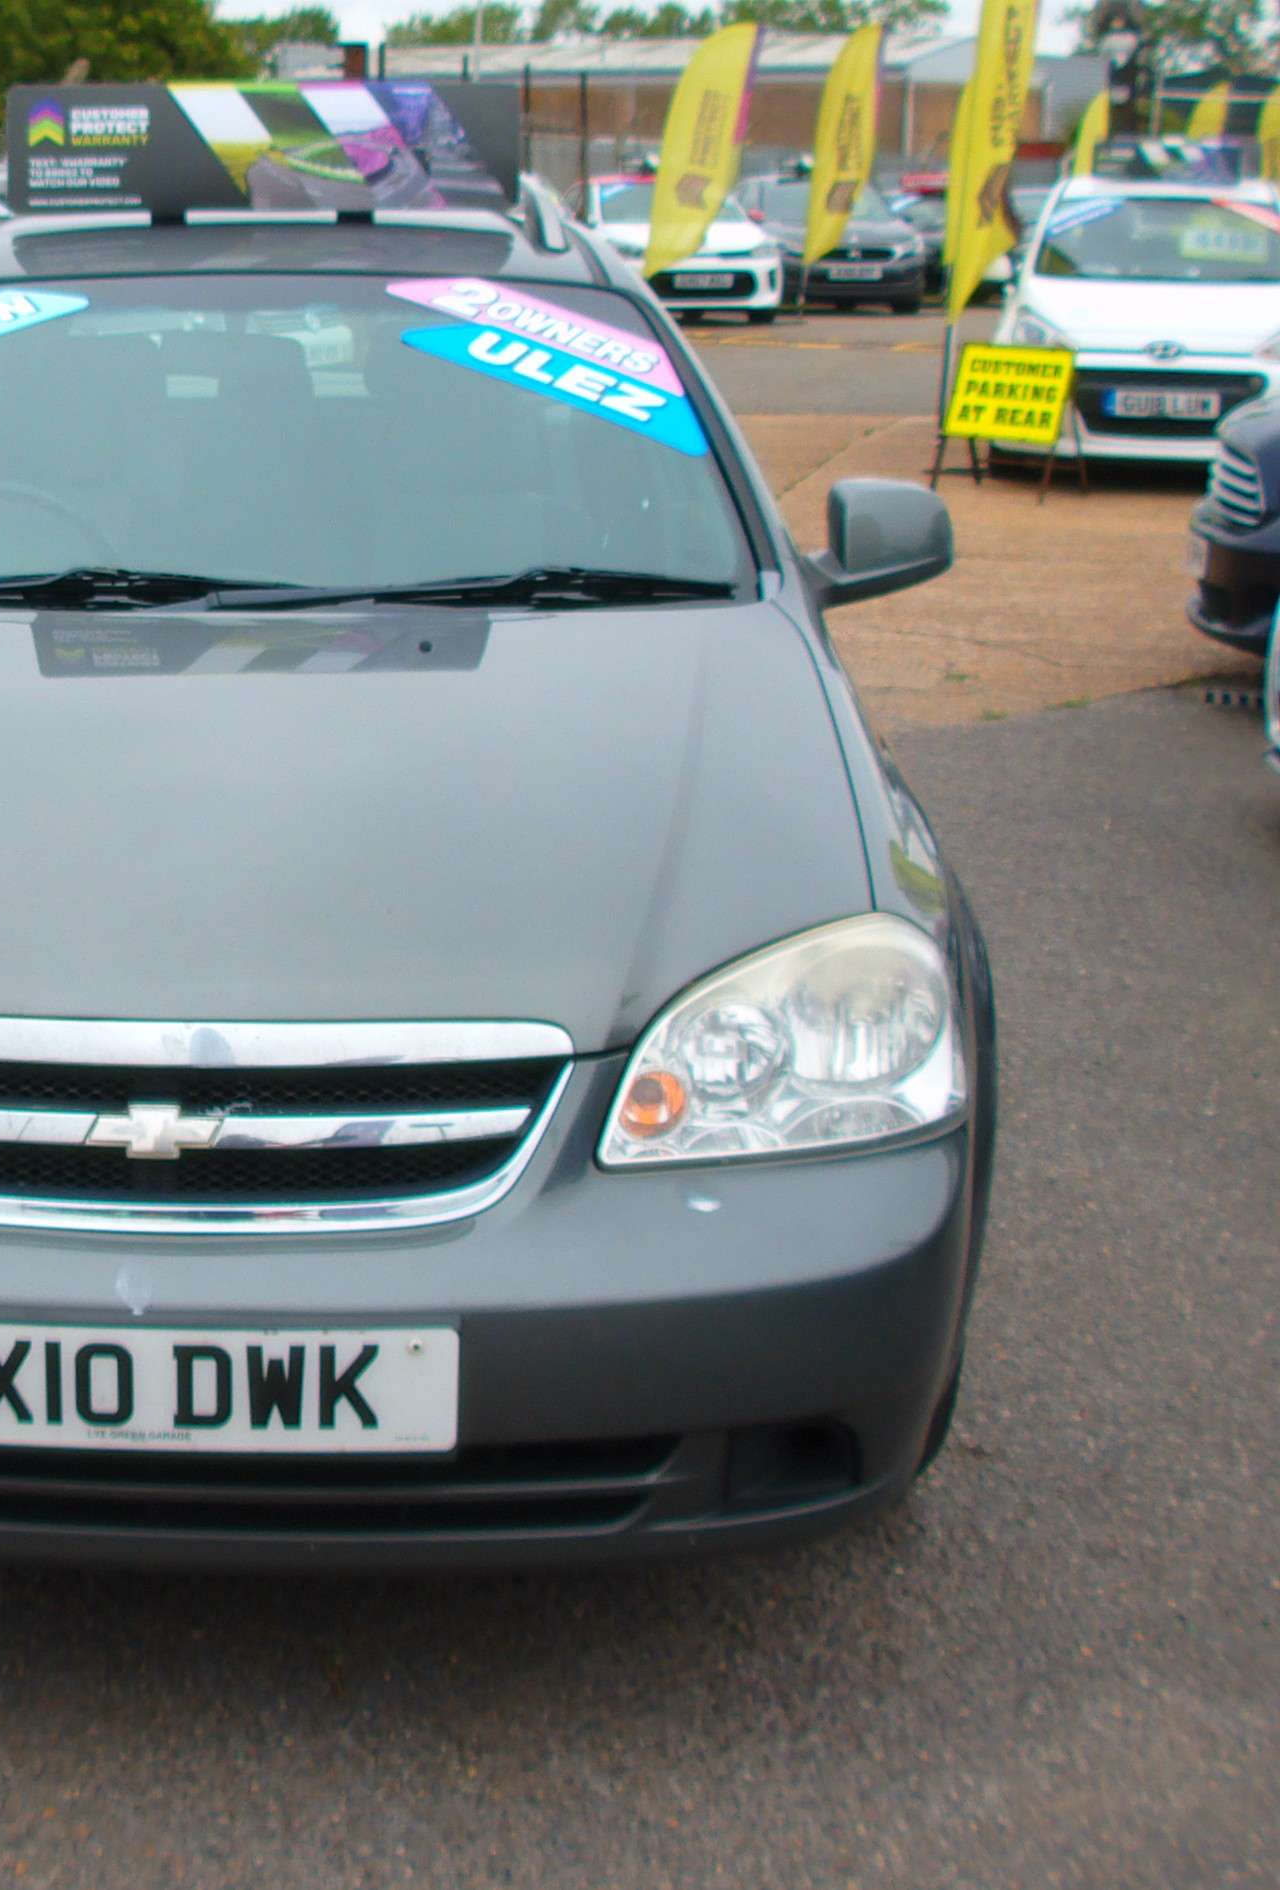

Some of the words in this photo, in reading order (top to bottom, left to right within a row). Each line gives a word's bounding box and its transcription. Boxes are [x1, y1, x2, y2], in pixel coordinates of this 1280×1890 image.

[70, 120, 148, 134] PROTECT
[71, 134, 149, 146] WARRANTY
[431, 281, 500, 319] 2
[486, 302, 660, 374] OWNERS
[467, 331, 667, 422] ULEZ
[970, 359, 1063, 379] CUSTOMER
[965, 380, 1058, 403] PARKING
[958, 404, 988, 421] AT
[993, 407, 1052, 431] REAR
[173, 1343, 381, 1430] DWK
